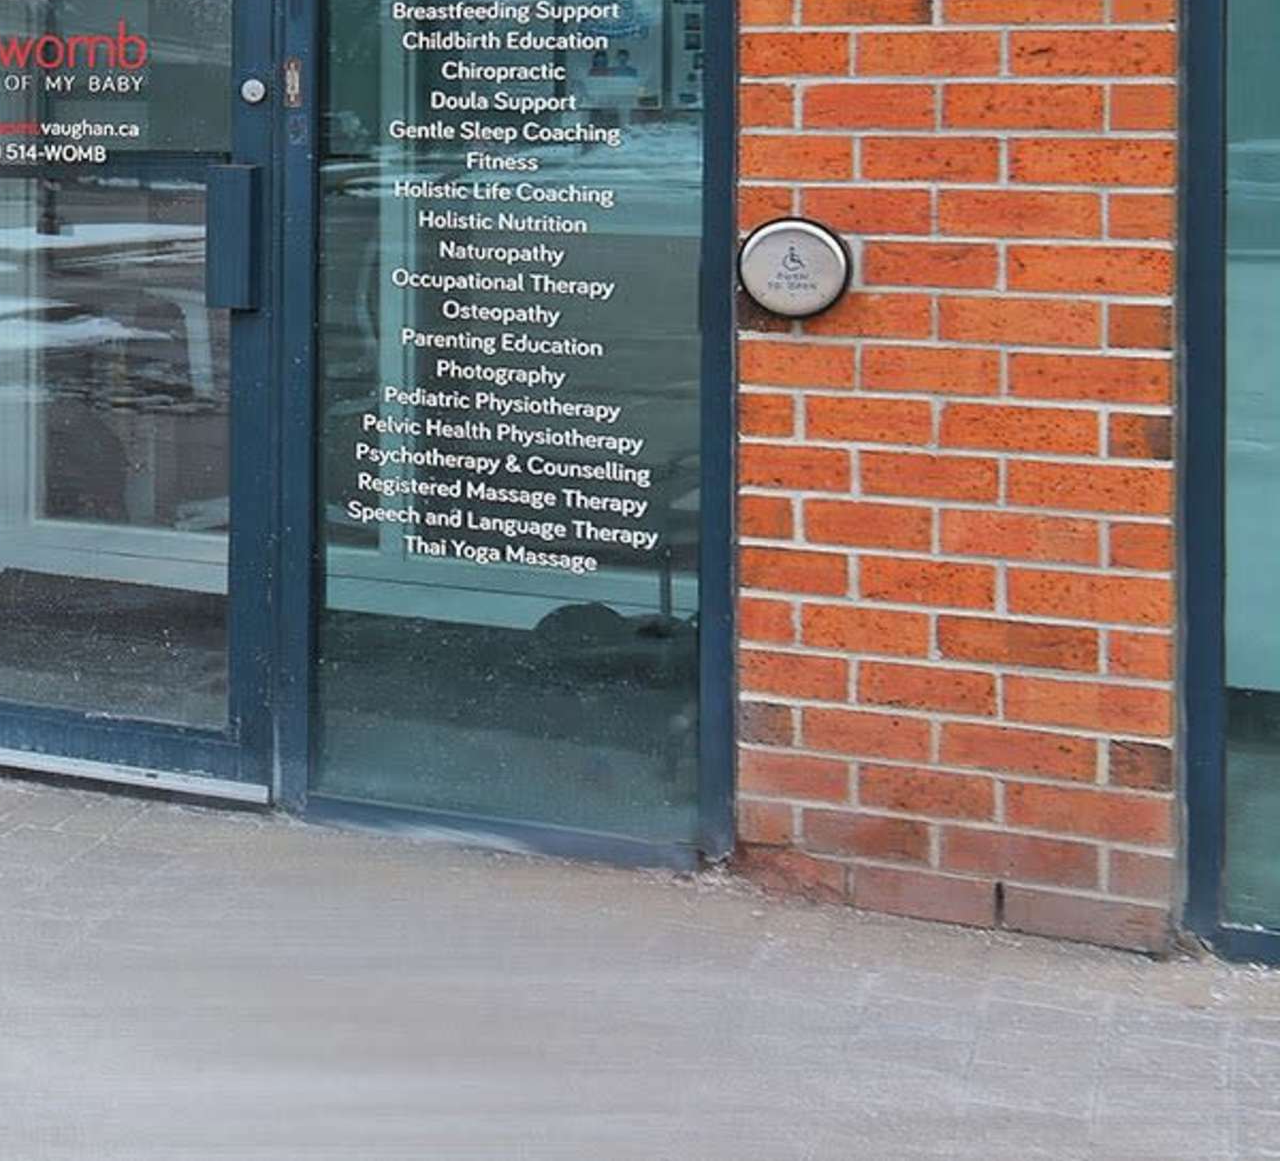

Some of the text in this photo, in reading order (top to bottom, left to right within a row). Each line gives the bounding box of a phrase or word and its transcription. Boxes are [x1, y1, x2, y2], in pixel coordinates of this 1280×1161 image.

[393, 1, 620, 23] Breastfeeding Support
[402, 31, 608, 51] Childbirth Education
[4, 74, 32, 91] OF
[46, 75, 76, 92] MY
[89, 75, 143, 93] BABY
[441, 62, 566, 83] Chiropractic
[431, 92, 576, 115] Doula Support
[390, 120, 621, 146] Gentle Sleep Coaching
[6, 144, 107, 162] 514-WOMB
[466, 152, 539, 171] Fitness
[394, 182, 614, 207] Holistic Life Coaching
[418, 211, 587, 233] Holistic Nutrition
[439, 241, 564, 267] Naturopathy
[392, 269, 615, 300] Occupational Therapy
[442, 301, 560, 328] Osteopathy
[402, 329, 602, 356] Parenting Education
[436, 360, 565, 389] Photography
[384, 387, 621, 423] Pediatric Physiotherapy
[363, 415, 643, 456] Pelvic Health Physiotherapy
[356, 443, 651, 487] Psychotherapy & Counselling
[358, 474, 648, 517] Registered Massage Therapy
[348, 501, 658, 549] Speech and Language Therapy
[404, 536, 598, 574] Thai Yoga Massage
